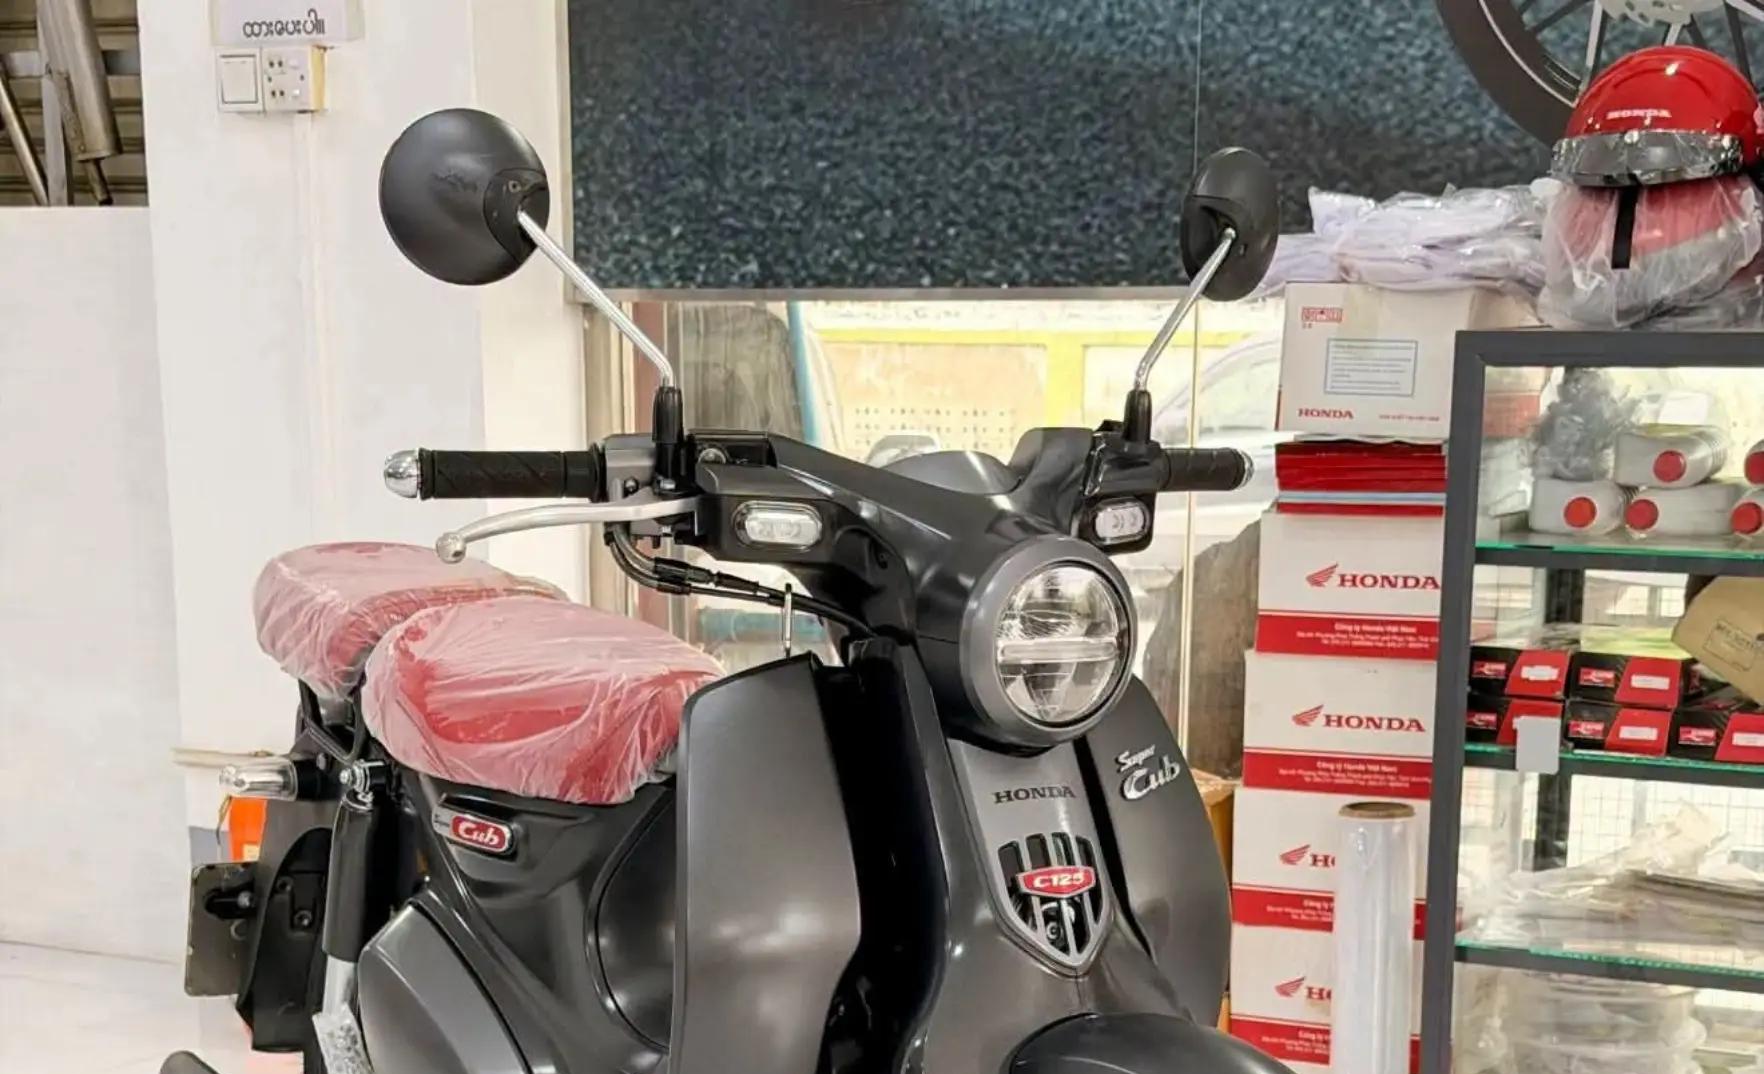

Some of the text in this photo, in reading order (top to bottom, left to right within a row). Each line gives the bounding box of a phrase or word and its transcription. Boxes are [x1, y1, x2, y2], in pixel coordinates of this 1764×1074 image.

[1298, 407, 1355, 420] HONDA
[1337, 573, 1441, 590] HONDA
[1323, 714, 1426, 732] HONDA
[1117, 744, 1156, 772] Super
[1122, 754, 1181, 800] Cub
[993, 785, 1077, 804] HONDA
[458, 821, 499, 845] Cub
[1033, 871, 1085, 888] C125
